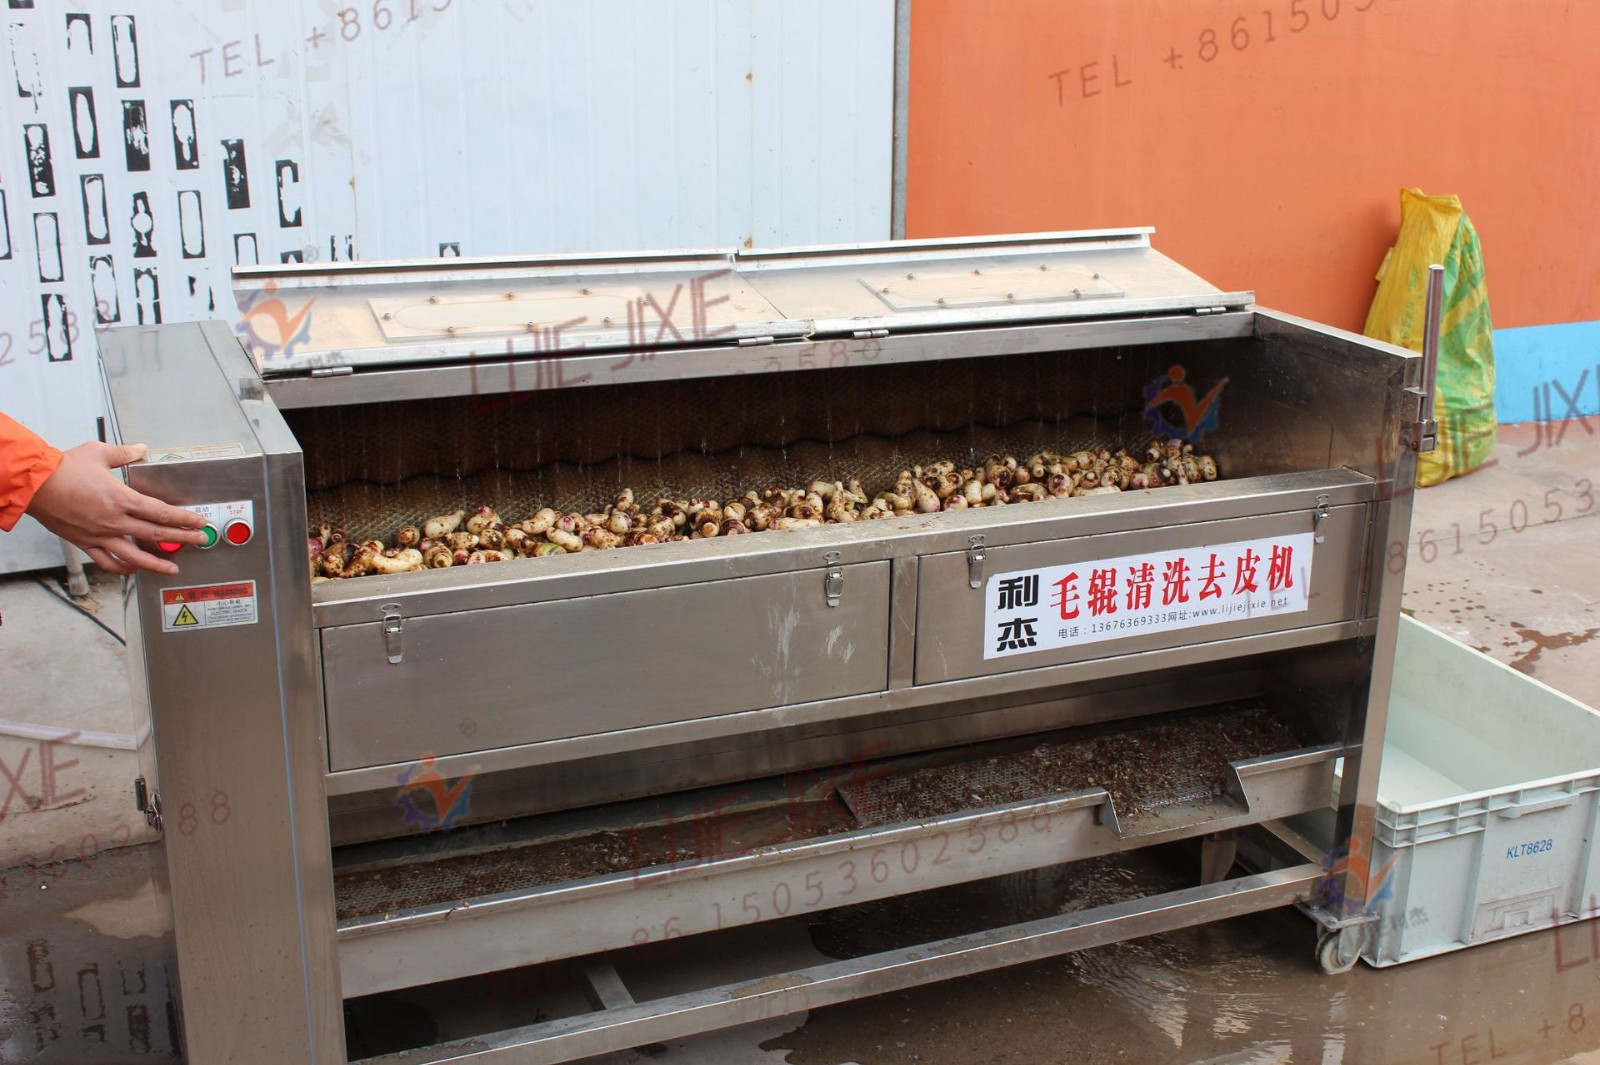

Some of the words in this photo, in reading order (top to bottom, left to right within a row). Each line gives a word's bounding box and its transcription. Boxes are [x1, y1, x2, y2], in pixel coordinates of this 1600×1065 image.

[1050, 545, 1294, 621] 毛辊清洗去皮机
[1506, 838, 1553, 859] KLT8628
